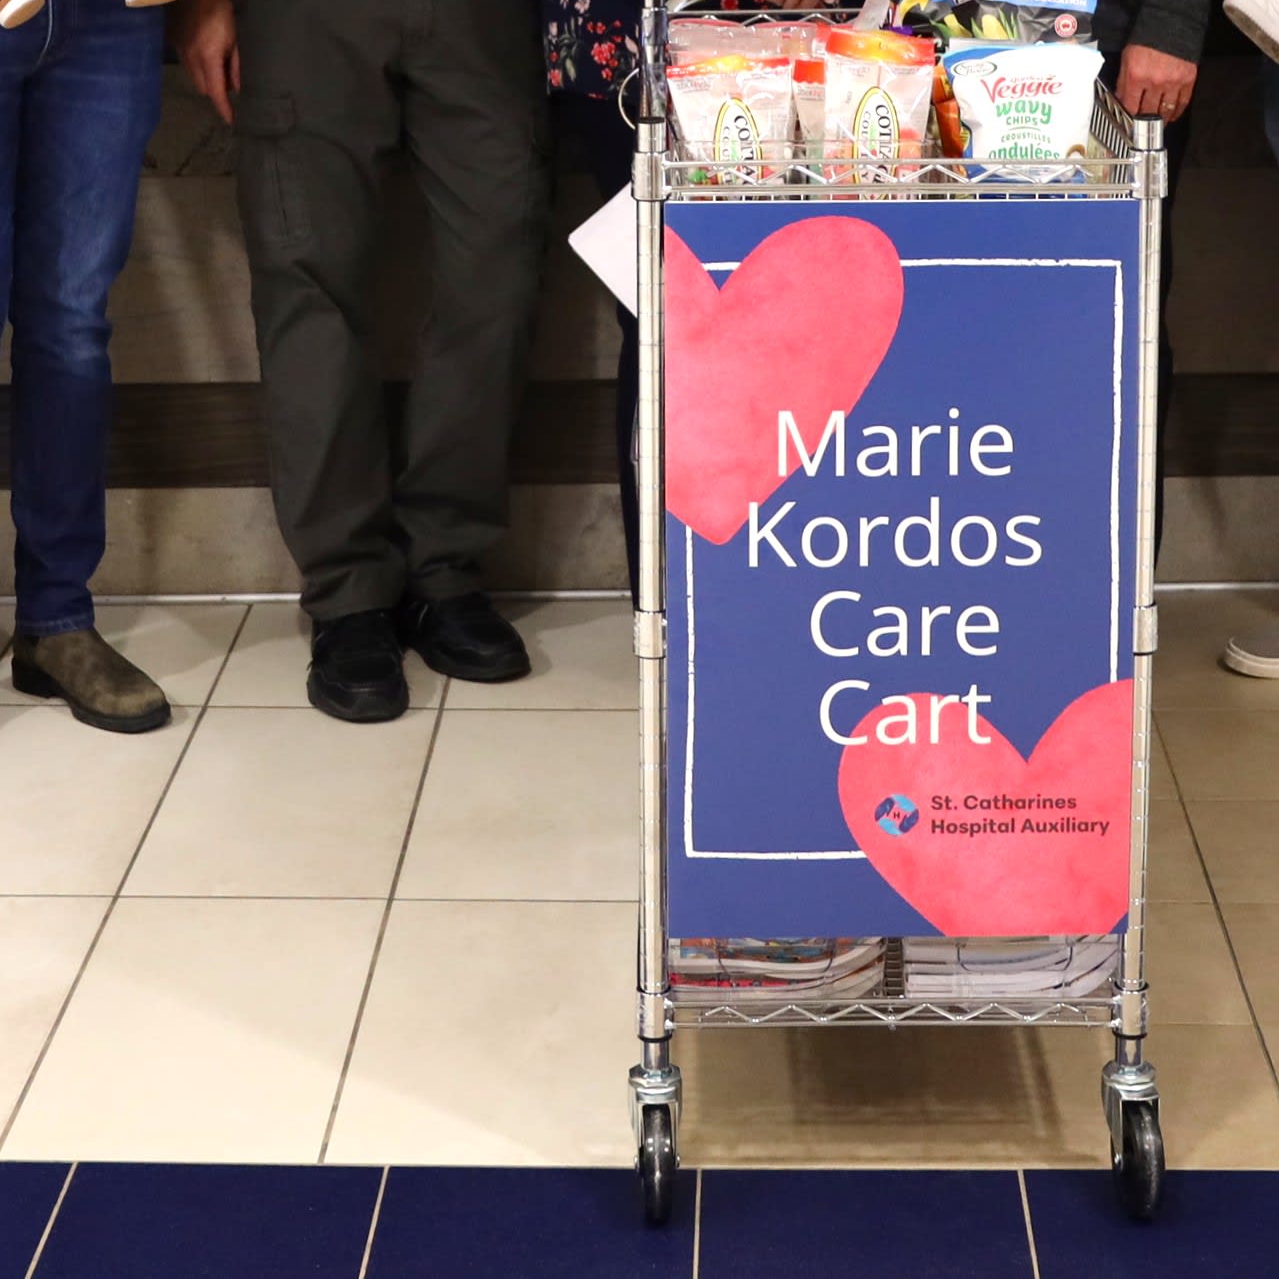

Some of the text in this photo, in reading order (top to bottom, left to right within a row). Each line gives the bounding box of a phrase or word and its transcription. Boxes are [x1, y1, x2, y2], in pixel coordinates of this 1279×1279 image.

[980, 76, 1062, 103] Veggie
[995, 99, 1053, 124] wavy
[1006, 115, 1038, 126] CHIPS
[1000, 132, 1052, 144] CROUSTILLES
[777, 407, 1014, 477] Marie
[747, 495, 1043, 568] Kordos
[809, 589, 1000, 658] Care
[819, 678, 992, 746] Cart
[930, 793, 1077, 811] St. Catharines
[930, 817, 1110, 838] Hospital Auxiliary
